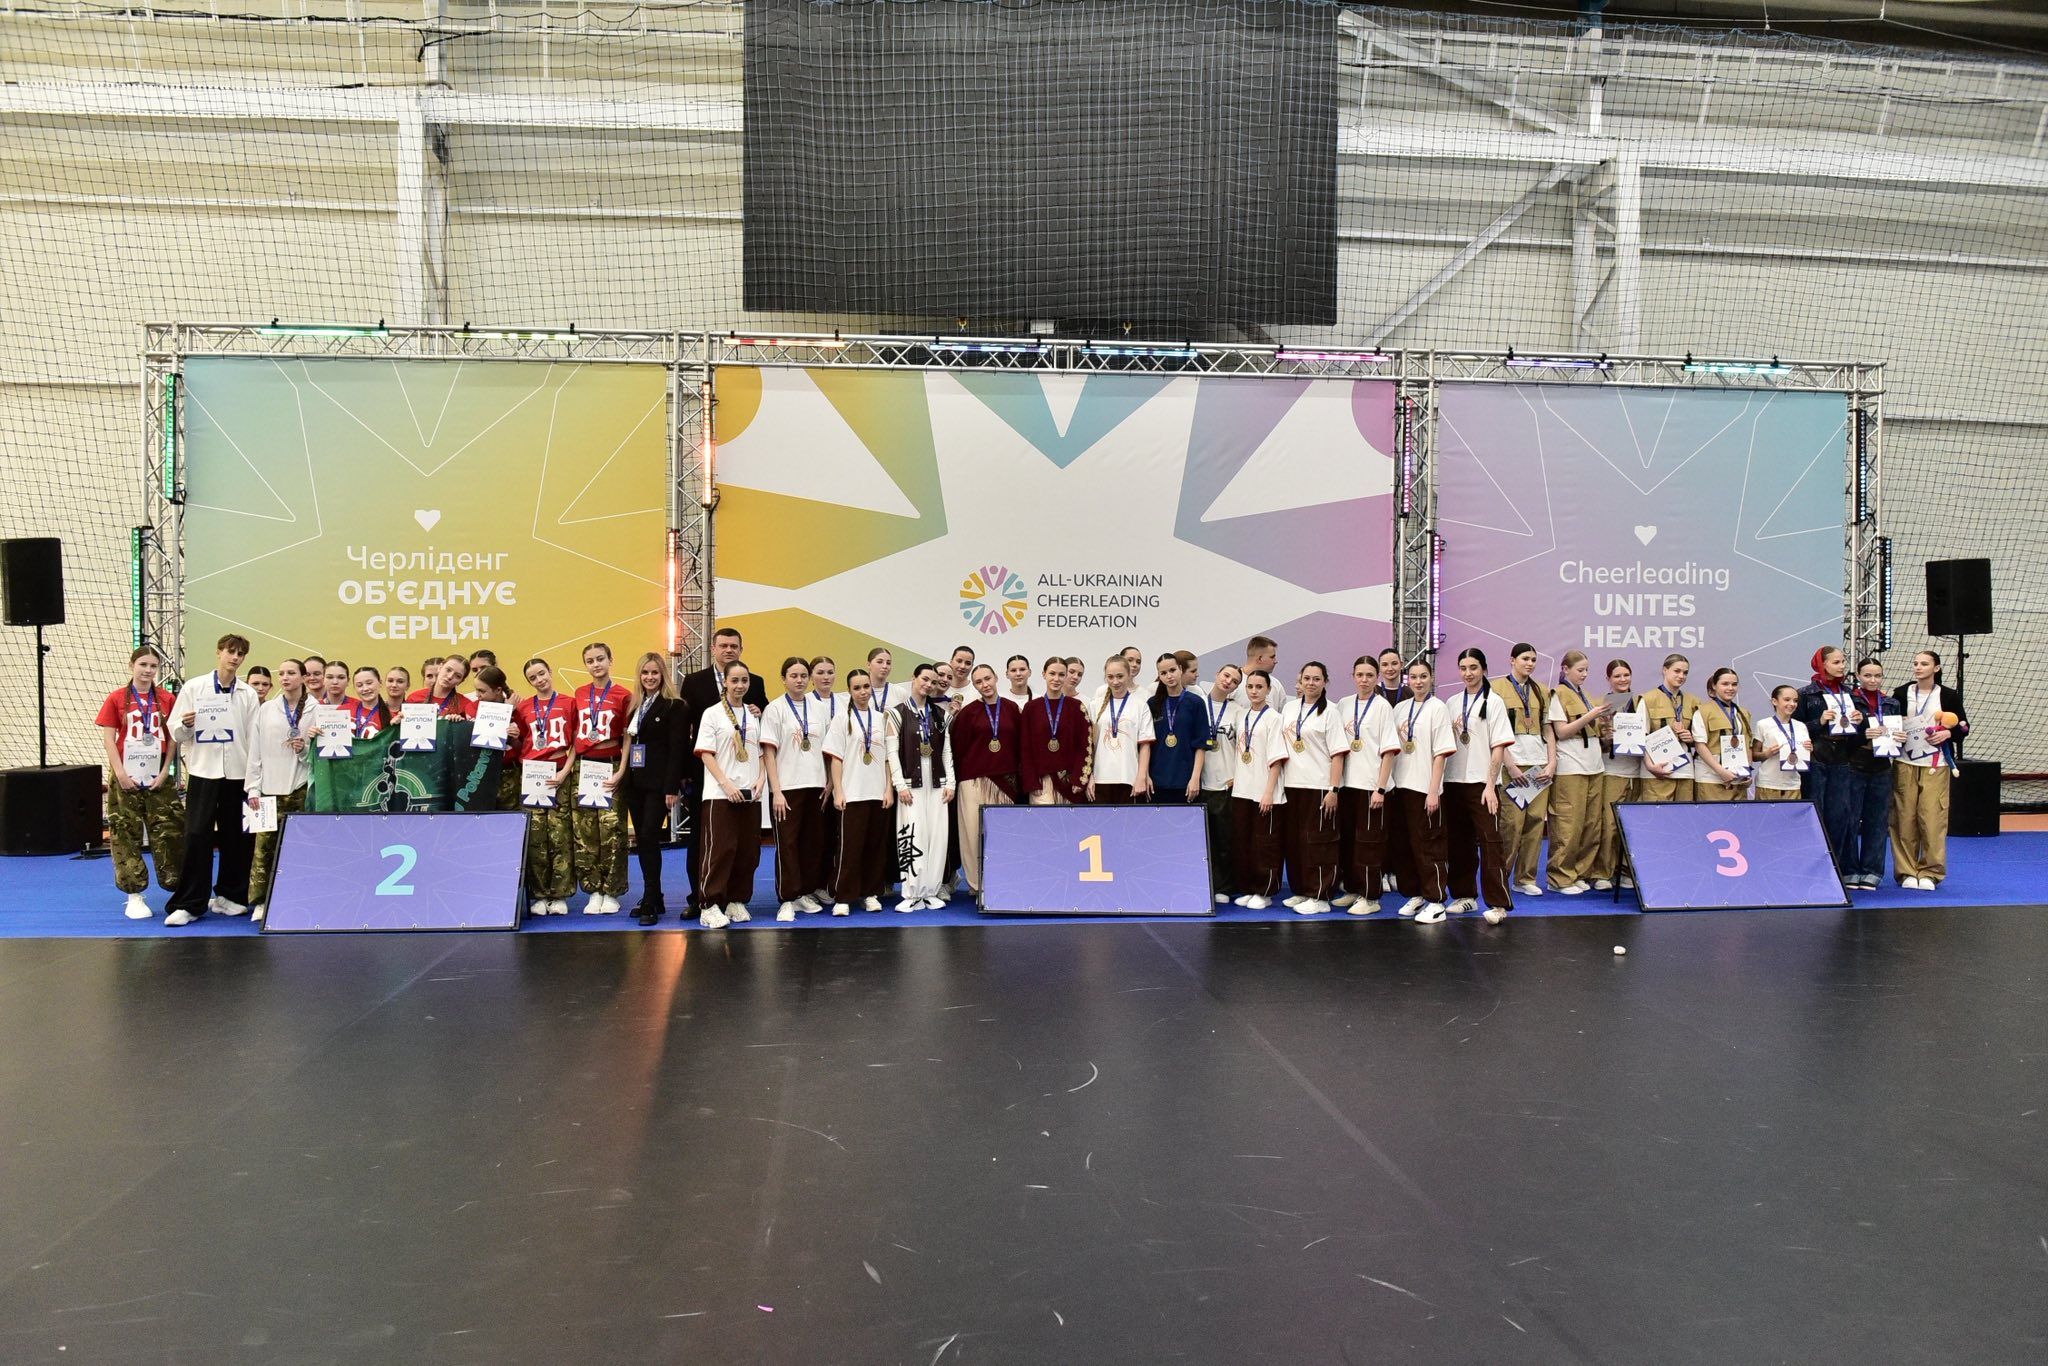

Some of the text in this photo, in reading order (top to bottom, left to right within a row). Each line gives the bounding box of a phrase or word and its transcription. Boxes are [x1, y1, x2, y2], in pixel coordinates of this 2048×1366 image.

[347, 545, 509, 576] Черліденг
[1559, 560, 1730, 591] Cheerleading
[338, 580, 517, 610] ОБ’ЄДНУЄ
[1037, 573, 1163, 587] ALL-UKRAINIAN
[1037, 594, 1160, 608] CHEERLEADING
[1593, 593, 1696, 617] UNITES
[366, 615, 490, 645] СЕРЦЯ!
[1038, 615, 1137, 628] FEDERATION
[1584, 625, 1705, 649] HEARTS!
[479, 714, 507, 722] ДИПЛОМ
[577, 707, 615, 741] 69
[1079, 835, 1113, 882] 1
[1706, 830, 1748, 877] 3
[375, 844, 417, 896] 2
